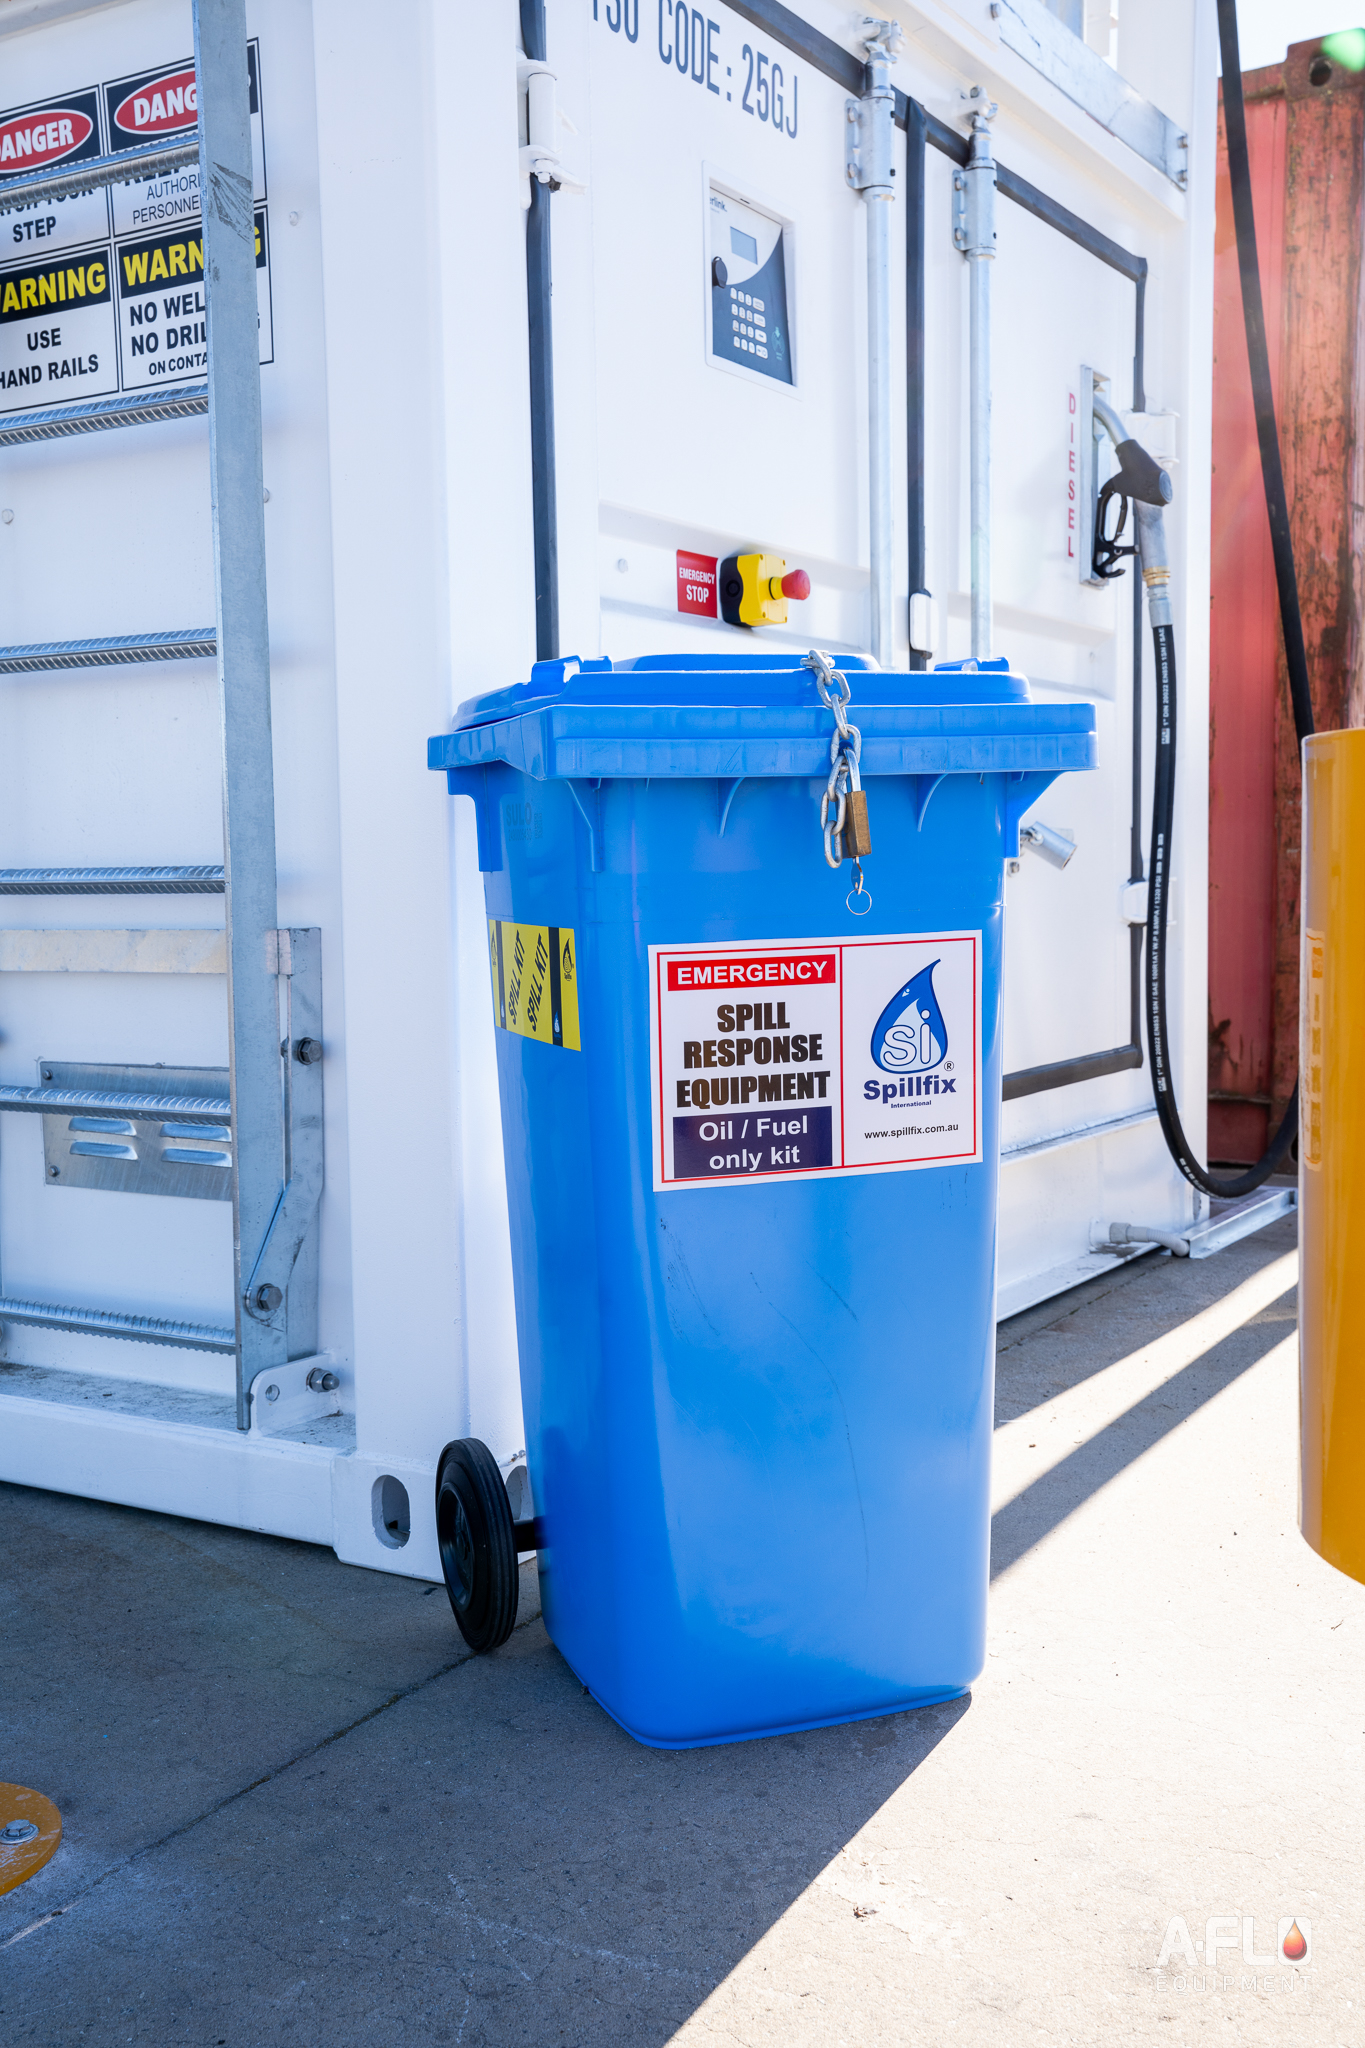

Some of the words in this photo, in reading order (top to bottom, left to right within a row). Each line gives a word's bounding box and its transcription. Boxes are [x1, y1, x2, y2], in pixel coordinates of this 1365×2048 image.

[133, 82, 198, 126] DANG
[741, 43, 798, 139] 25GJ
[0, 118, 75, 162] ANGER
[146, 172, 200, 200] AUTHORI
[132, 194, 201, 225] PERSONNE
[12, 215, 57, 243] STEP
[0, 262, 107, 314] ARNING
[129, 301, 157, 327] NO
[163, 291, 206, 320] WEL
[26, 327, 62, 351] USE
[131, 332, 159, 356] NO
[166, 321, 206, 350] DRIL
[48, 354, 99, 381] RAILS
[148, 360, 166, 376] ON
[168, 352, 208, 372] CONTA
[1068, 392, 1076, 558] DIESEL
[679, 567, 715, 584] EMERGENCY
[686, 584, 709, 603] STOP
[506, 802, 532, 827] SULO
[514, 929, 525, 976] KIT
[534, 932, 548, 981] KIT
[677, 961, 827, 985] EMERGENCY
[508, 969, 522, 1026] SPILL
[527, 973, 543, 1032] SPILL
[717, 1002, 791, 1033] SPILL
[683, 1033, 823, 1069] RESPONSE
[676, 1070, 831, 1109] EQUIPMENT
[863, 1074, 957, 1104] Spillfix
[890, 1100, 932, 1109] International
[699, 1120, 733, 1141] Oil
[740, 1119, 749, 1139] /
[756, 1115, 808, 1138] Fuel
[864, 1123, 959, 1139] www.spillfix.com.au
[709, 1148, 763, 1172] only
[770, 1146, 800, 1165] kit
